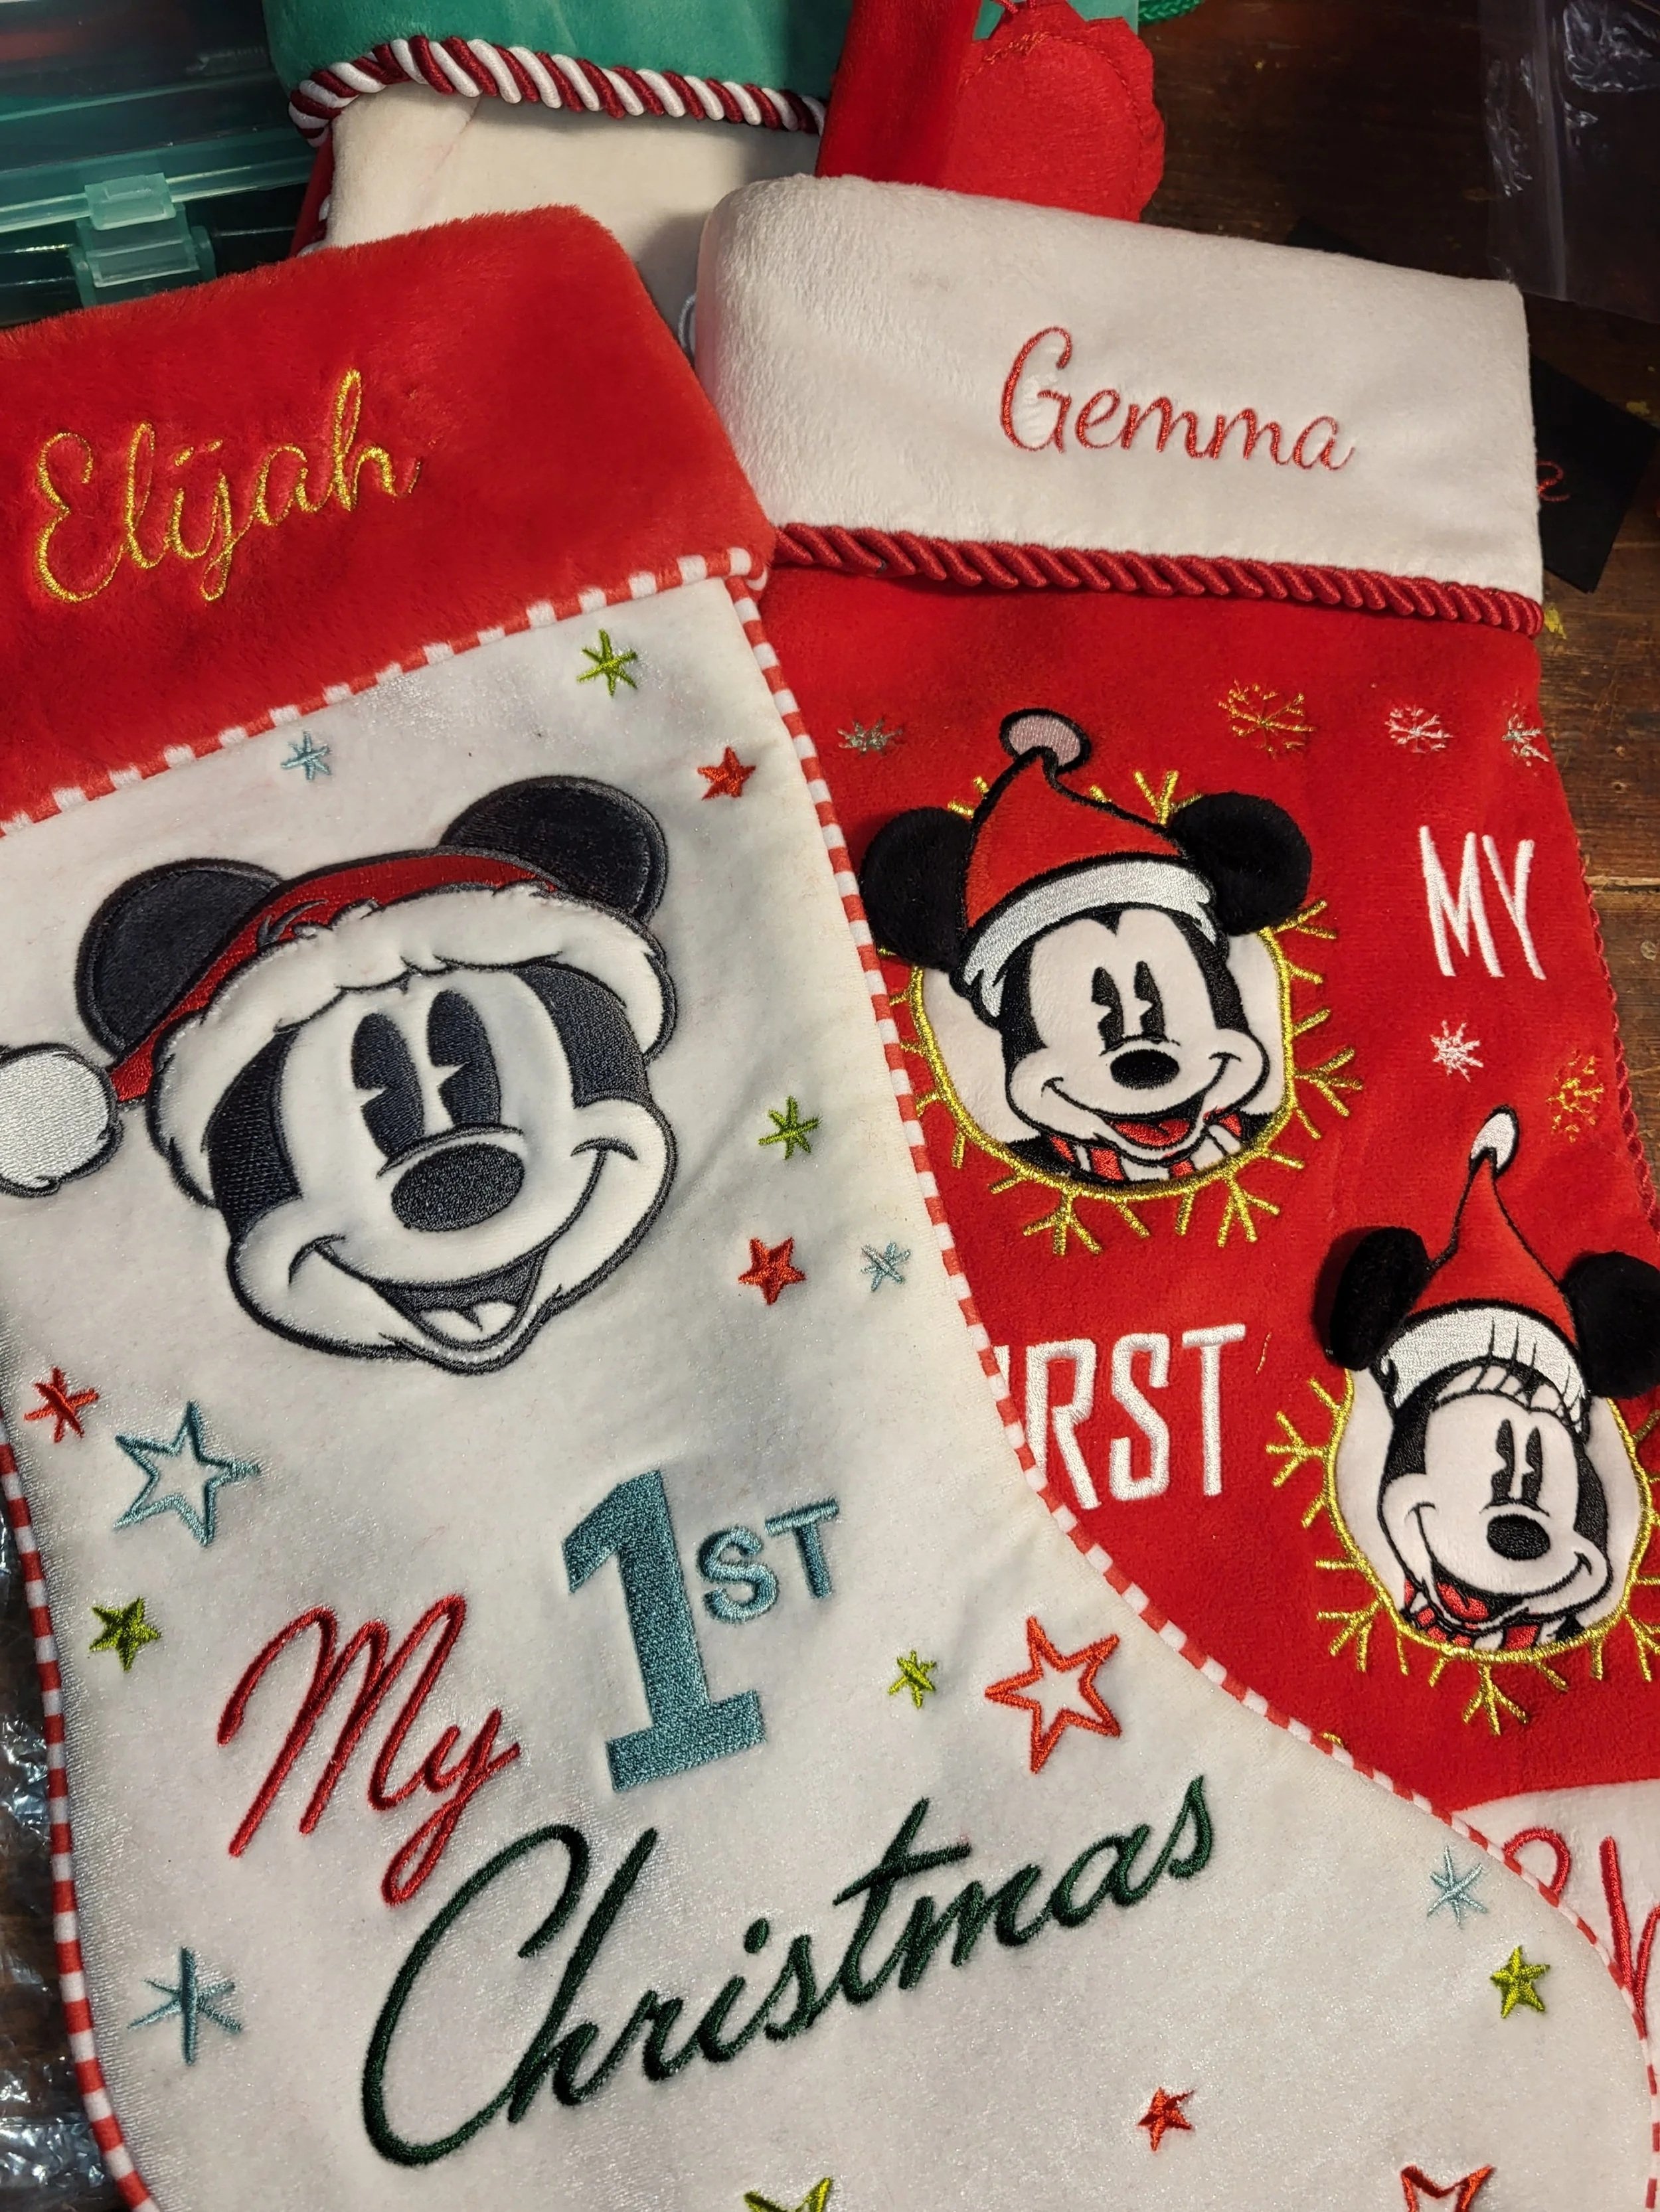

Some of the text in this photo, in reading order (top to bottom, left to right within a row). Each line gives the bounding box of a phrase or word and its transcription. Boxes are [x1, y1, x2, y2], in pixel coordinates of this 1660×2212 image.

[35, 368, 422, 603] Elijah
[999, 325, 1356, 471] Gemma
[1418, 825, 1547, 981] MY
[216, 1595, 521, 1907] My
[362, 1775, 1214, 2167] Christmas
